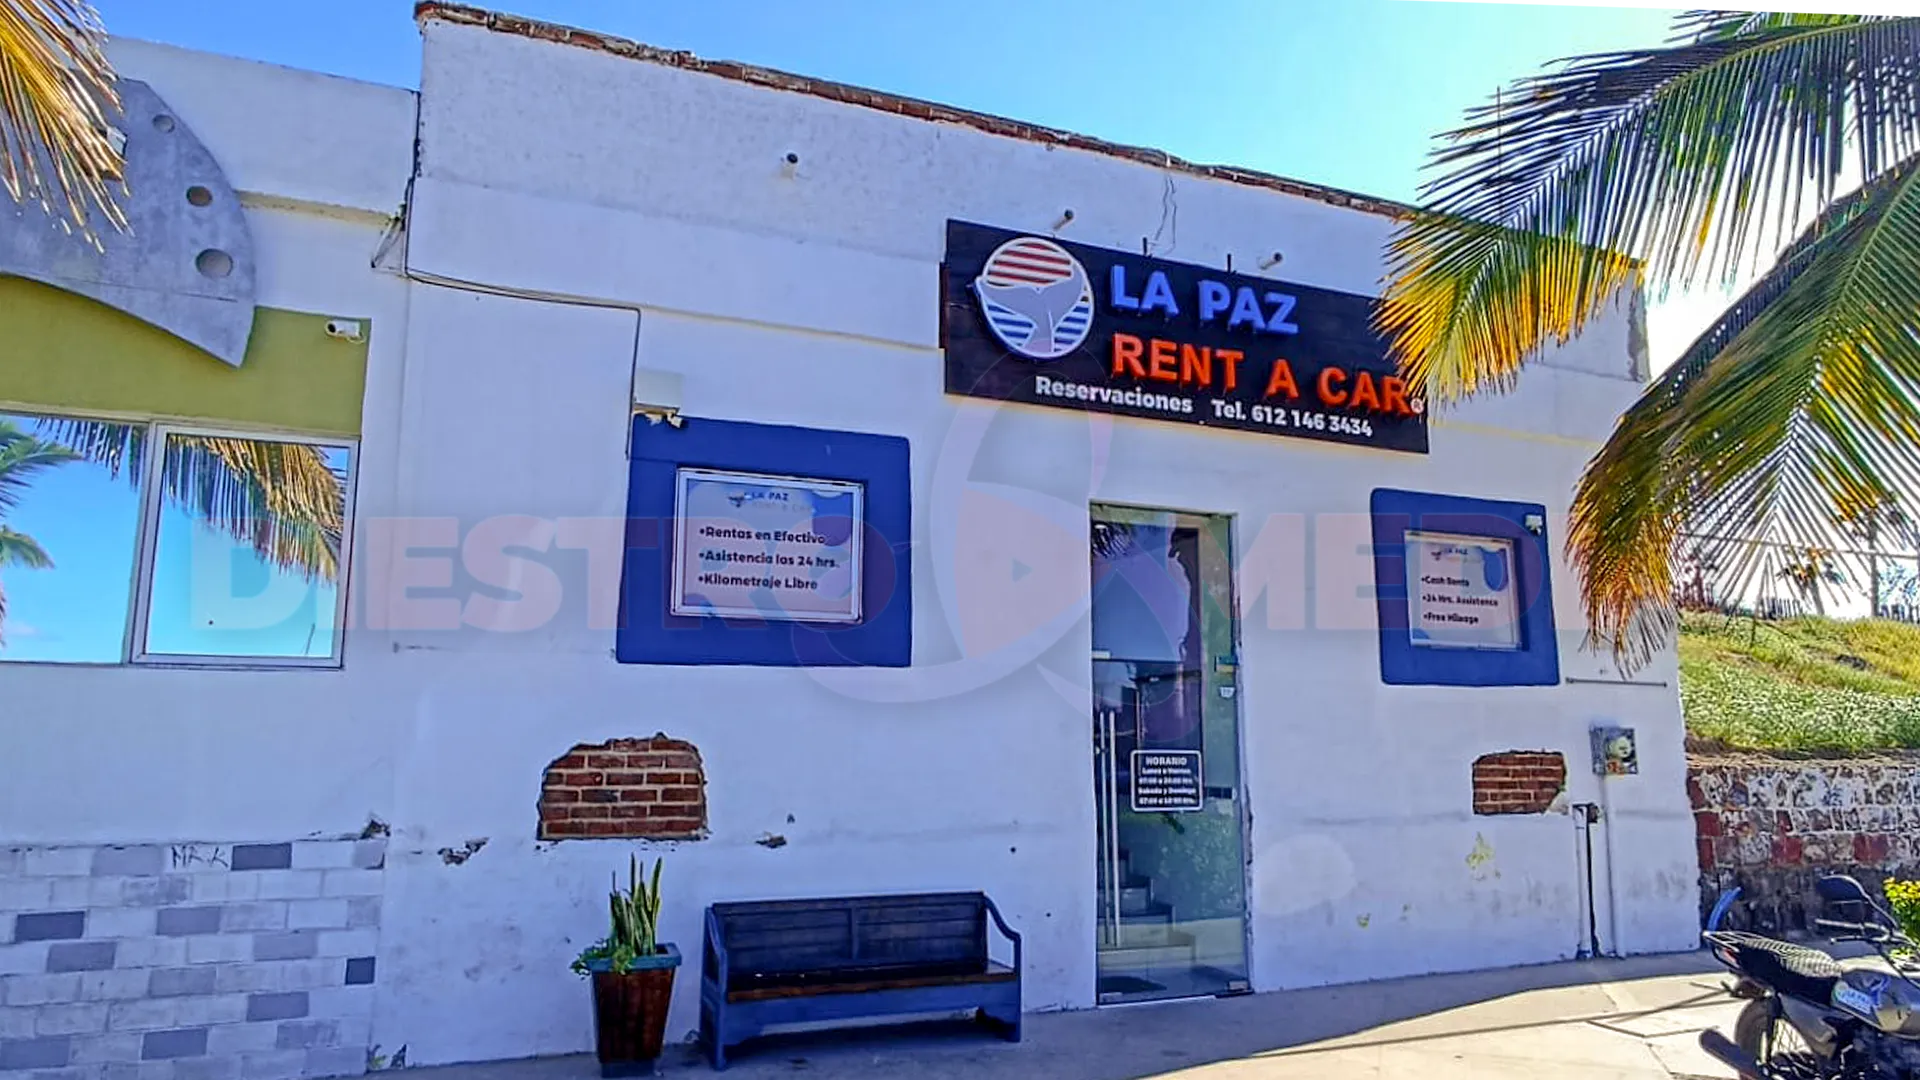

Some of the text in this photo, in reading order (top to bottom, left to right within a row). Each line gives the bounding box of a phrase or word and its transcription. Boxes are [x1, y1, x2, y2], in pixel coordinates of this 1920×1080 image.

[1110, 264, 1299, 334] LA PAZ
[1111, 332, 1413, 416] RENT A CAR
[1035, 375, 1373, 438] Reservaciones Tel. 612 146 3434
[705, 526, 827, 545] Rentas en Efectivo
[705, 550, 773, 565] Asistencia
[797, 556, 813, 566] 24
[704, 573, 818, 590] Kilometraje Libre
[1145, 756, 1187, 766] HORARIO
